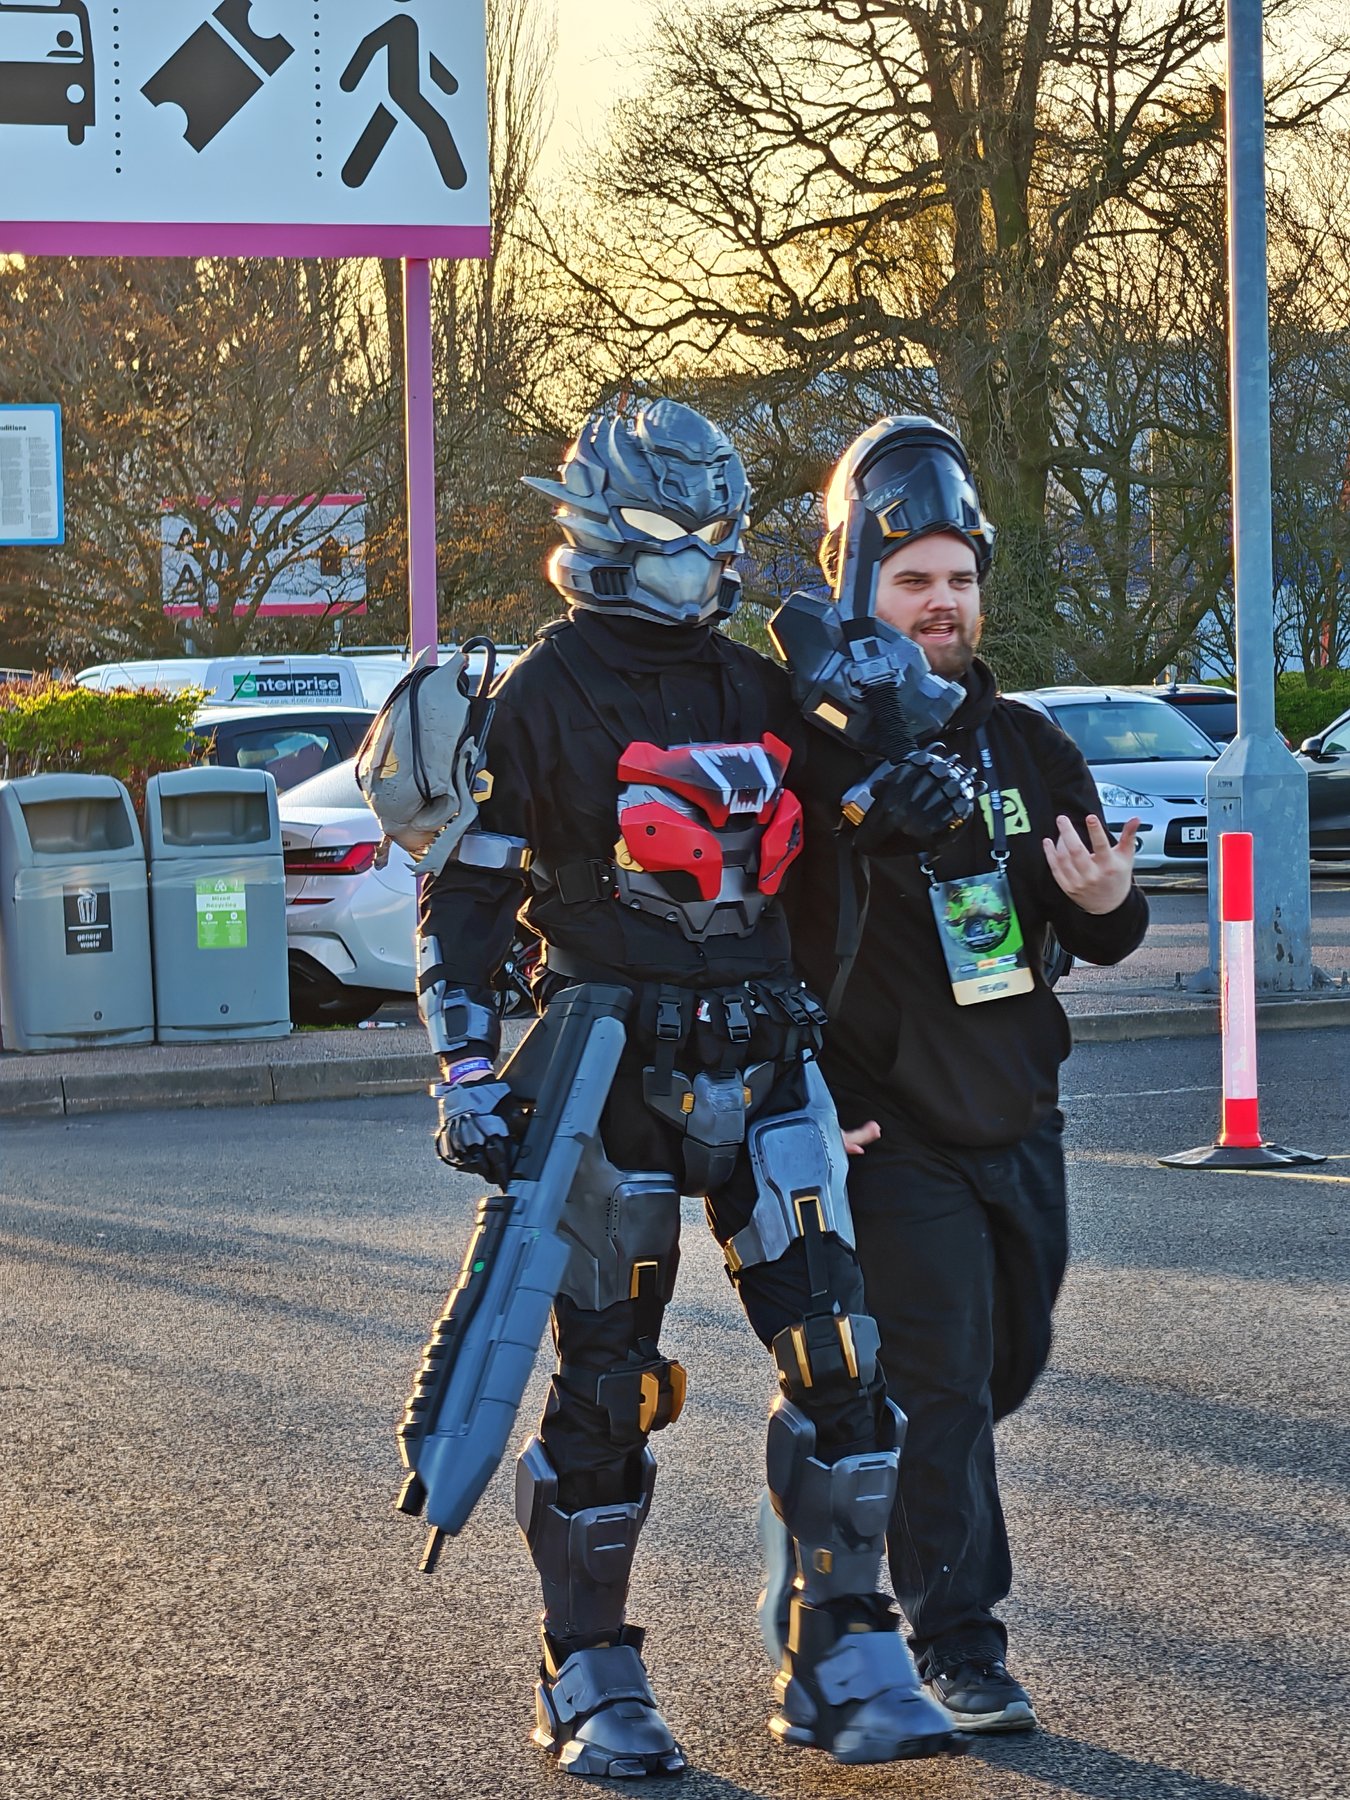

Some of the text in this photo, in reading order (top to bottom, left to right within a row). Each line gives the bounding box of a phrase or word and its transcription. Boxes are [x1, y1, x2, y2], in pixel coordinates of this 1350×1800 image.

[240, 675, 340, 694] enterprise
[77, 931, 102, 942] general
[80, 940, 100, 949] waste
